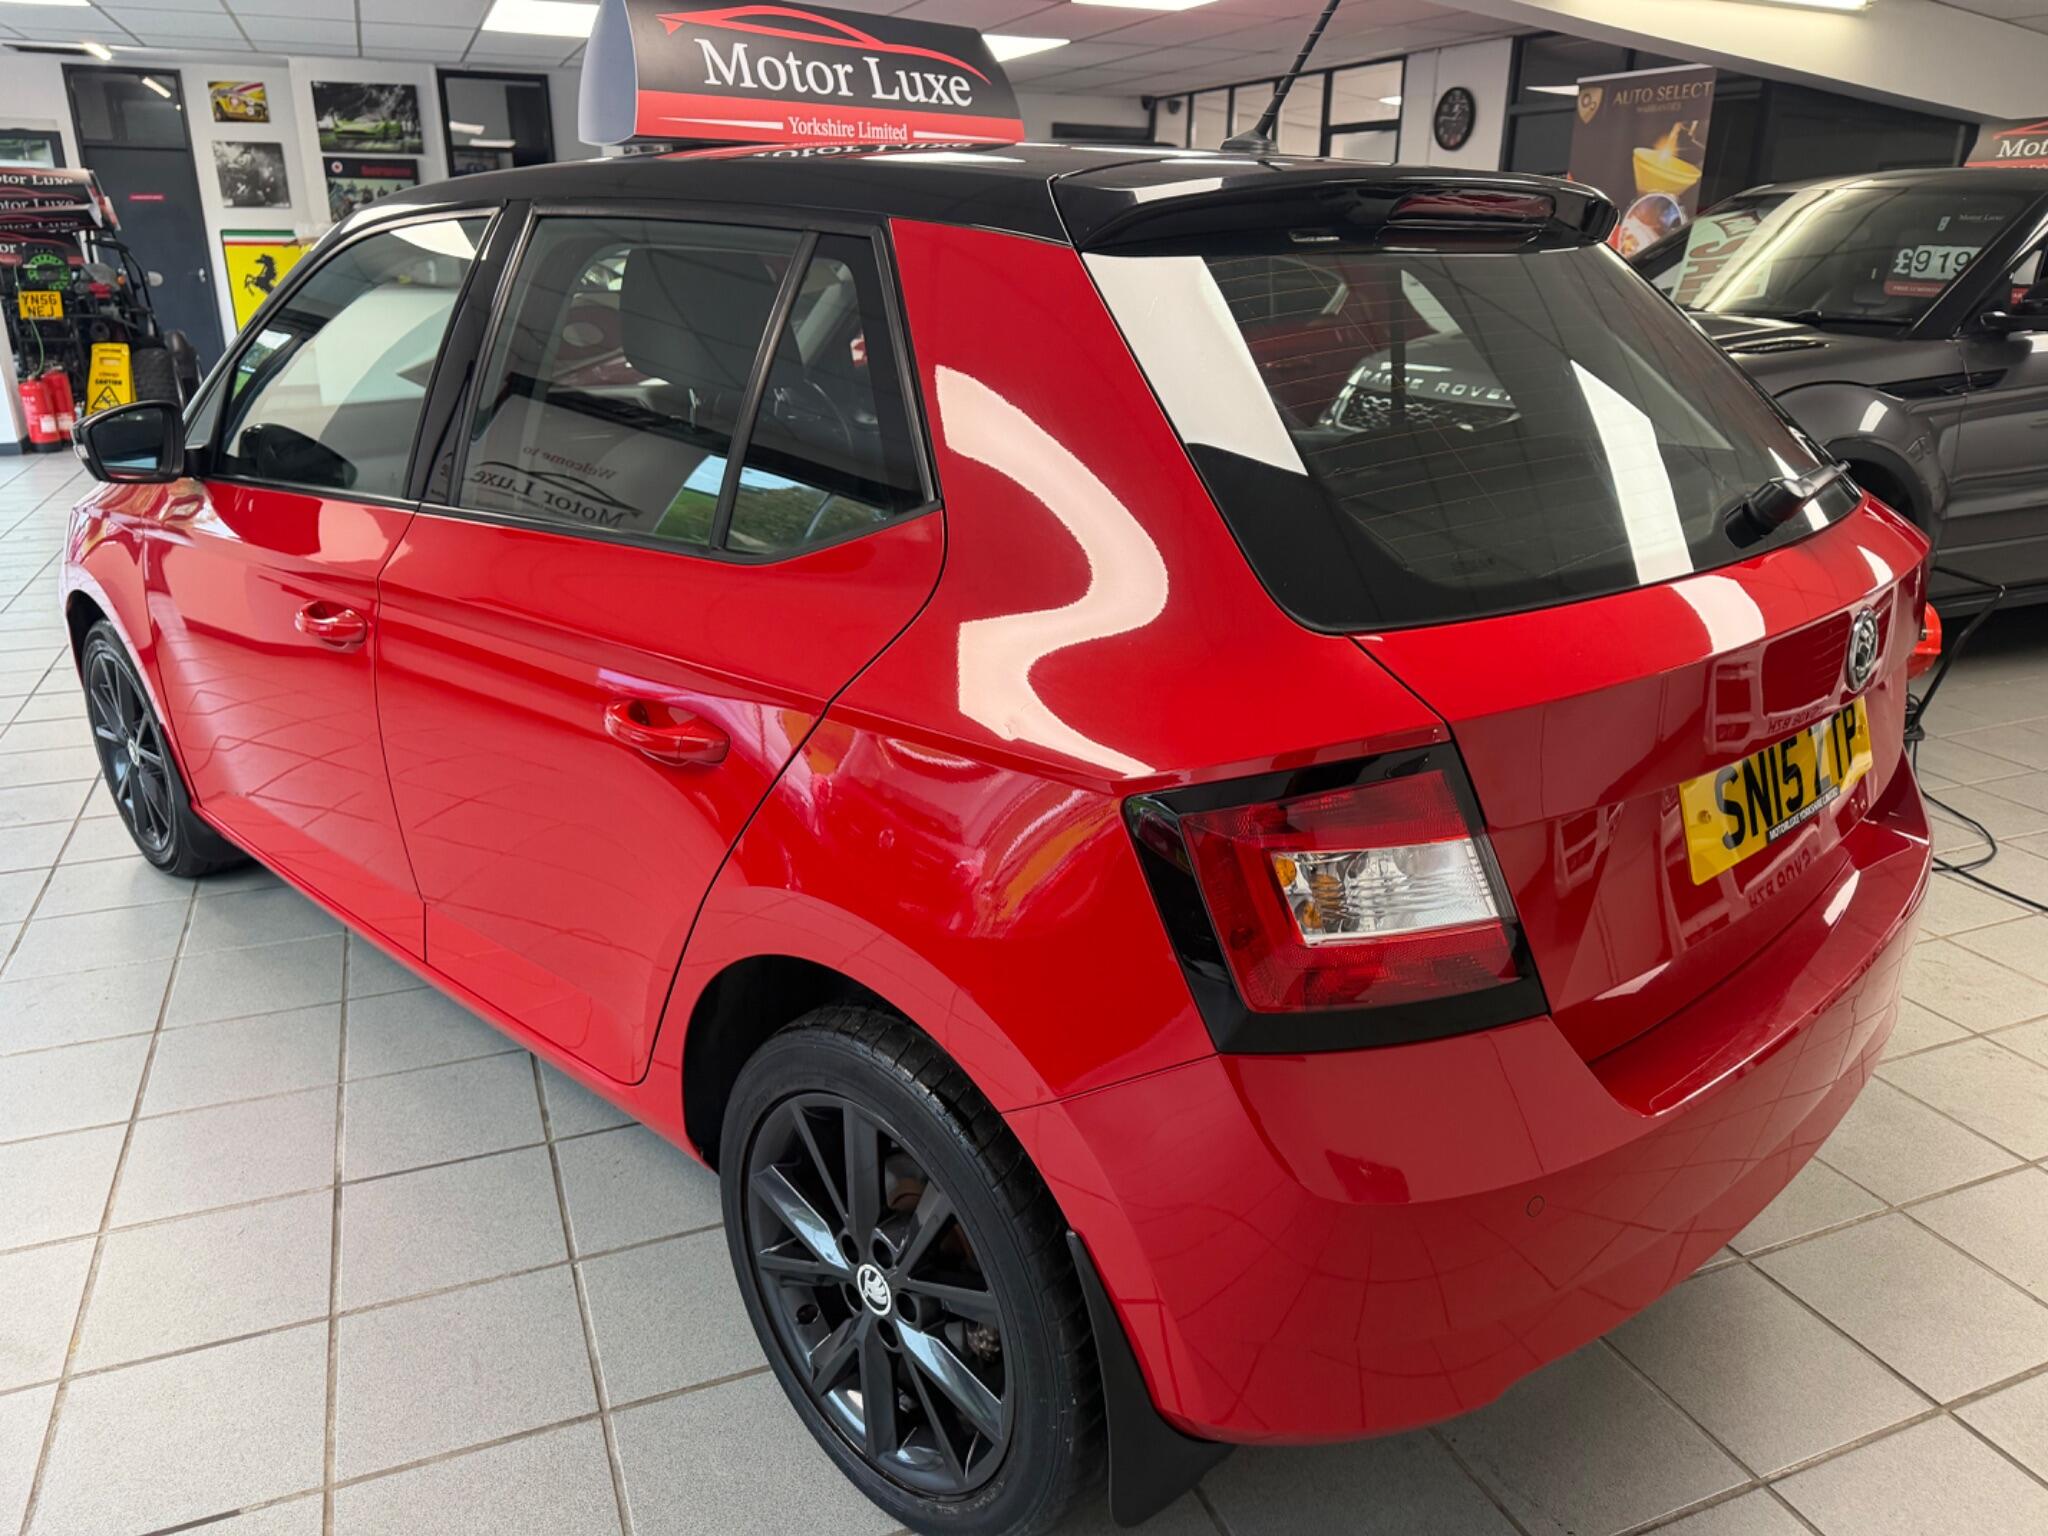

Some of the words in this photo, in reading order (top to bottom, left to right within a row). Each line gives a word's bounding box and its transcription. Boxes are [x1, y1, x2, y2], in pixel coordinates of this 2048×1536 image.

[694, 38, 853, 98] Motor
[863, 56, 973, 107] Luxe
[1612, 87, 1654, 105] AUTO
[1656, 81, 1713, 101] SELECT
[788, 115, 856, 138] Yorkshire
[858, 120, 908, 141] Limited
[0, 174, 27, 185] tor
[32, 174, 74, 186] Luxe
[21, 294, 57, 304] YN56
[1361, 370, 1424, 390] RANE
[1434, 382, 1511, 401] ROVE
[1714, 735, 1804, 850] SN15
